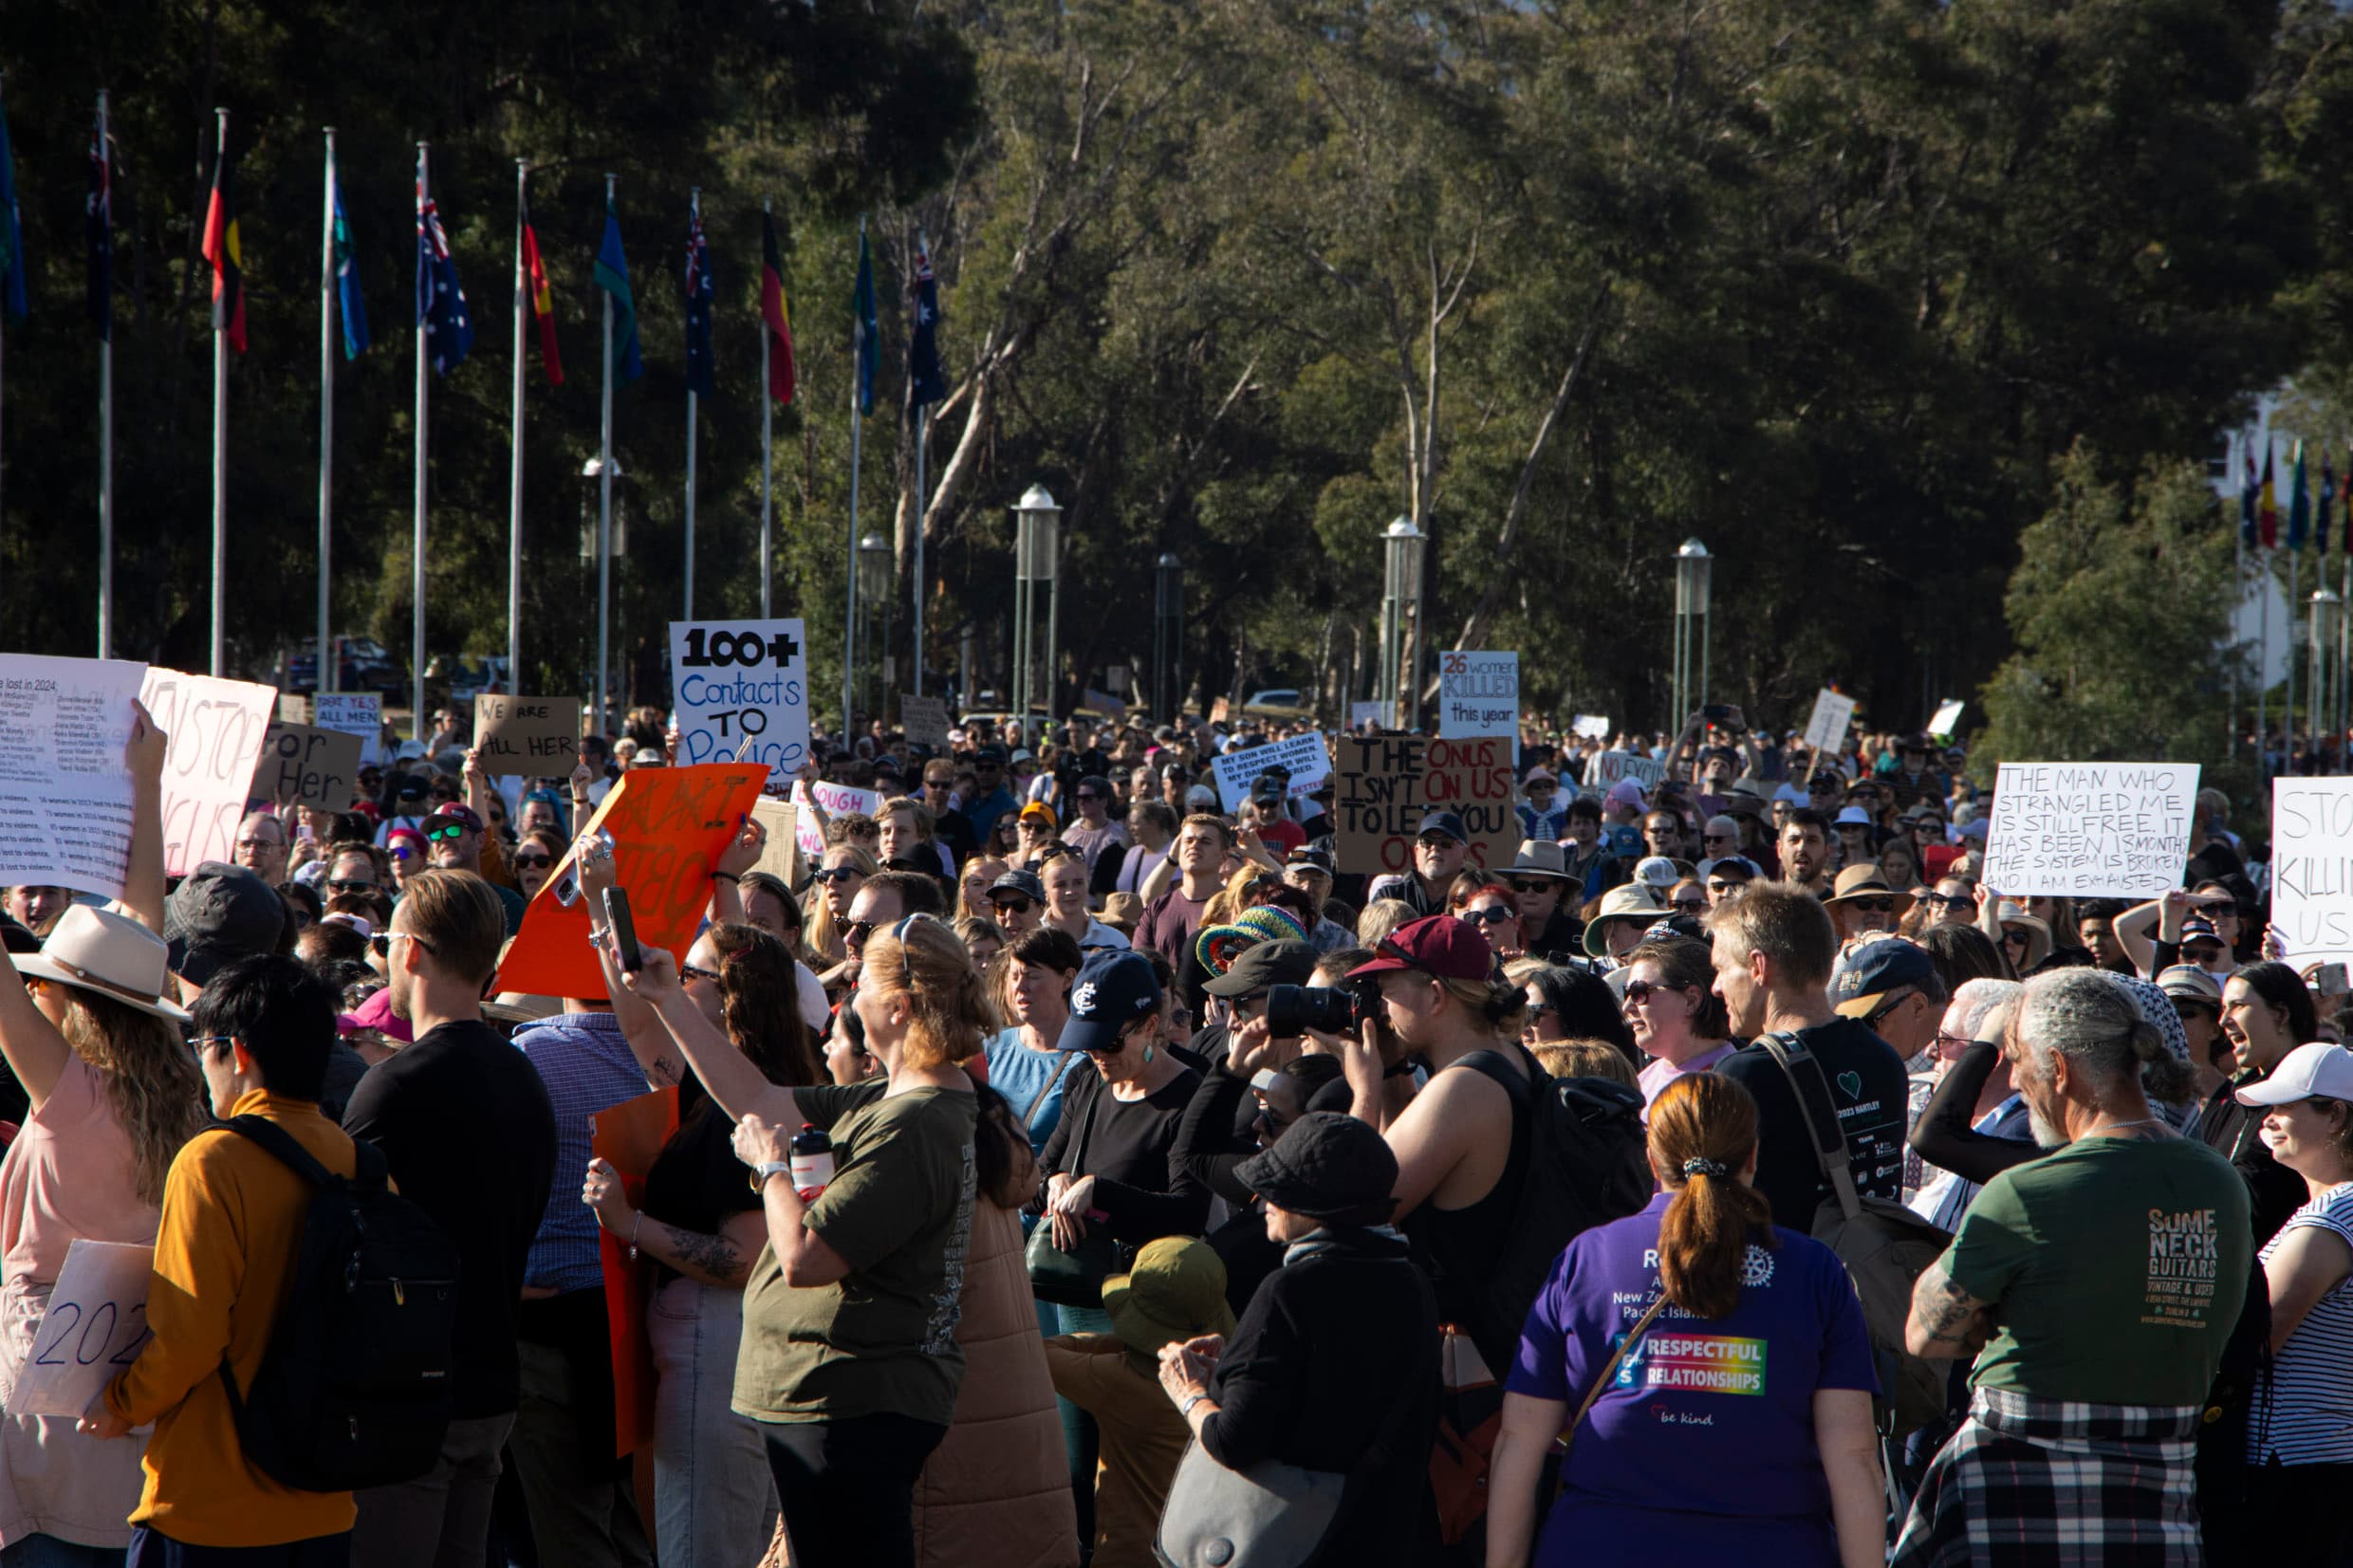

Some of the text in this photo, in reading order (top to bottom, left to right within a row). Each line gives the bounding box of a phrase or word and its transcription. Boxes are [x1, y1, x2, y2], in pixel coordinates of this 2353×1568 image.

[682, 628, 798, 668] 100+
[1444, 655, 1518, 674] 26 women
[24, 680, 32, 690] in
[681, 672, 800, 707] Contacts
[1443, 675, 1518, 698] KILLED
[349, 697, 377, 710] YES
[481, 699, 548, 719] WE ARE
[319, 711, 378, 722] ALL MEN
[709, 709, 767, 737] TO
[1452, 702, 1514, 729] this year
[480, 731, 575, 756] ALL HER
[1221, 756, 1235, 766] MY
[1238, 751, 1257, 762] SON
[1285, 736, 1315, 749] LEARN
[1237, 756, 1277, 770] RESPECT
[1352, 739, 1496, 773] THE ONUS
[1245, 760, 1293, 778] DAUER
[1601, 756, 1621, 782] NO
[2000, 767, 2175, 792] THE MAN WHO
[280, 762, 343, 802] Her
[1341, 767, 1511, 804] ISN'T ON US
[797, 786, 863, 811] EOUGH
[1998, 794, 2183, 815] STRANGLED ME
[1451, 803, 1505, 834] YOU
[1995, 814, 2185, 835] IS STILL FREE. IT
[1990, 835, 2032, 854] HAS
[2041, 835, 2103, 854] BEEN
[2136, 835, 2189, 854] MONTHS
[1986, 855, 2186, 872] THE SYSTEM IS BROKEN
[1986, 874, 2020, 890] AND
[2041, 875, 2066, 890] AM
[2075, 874, 2171, 892] EXHAUSTED
[2299, 911, 2349, 946] US
[2150, 1233, 2218, 1259] NECK
[2148, 1258, 2216, 1278] GUITARS
[1613, 1291, 1642, 1304] New
[2147, 1281, 2182, 1294] VINTAGE
[1647, 1338, 1762, 1361] RESPECTFUL
[1647, 1368, 1761, 1390] RELATIONSHIPS
[1661, 1411, 1714, 1426] be kind
